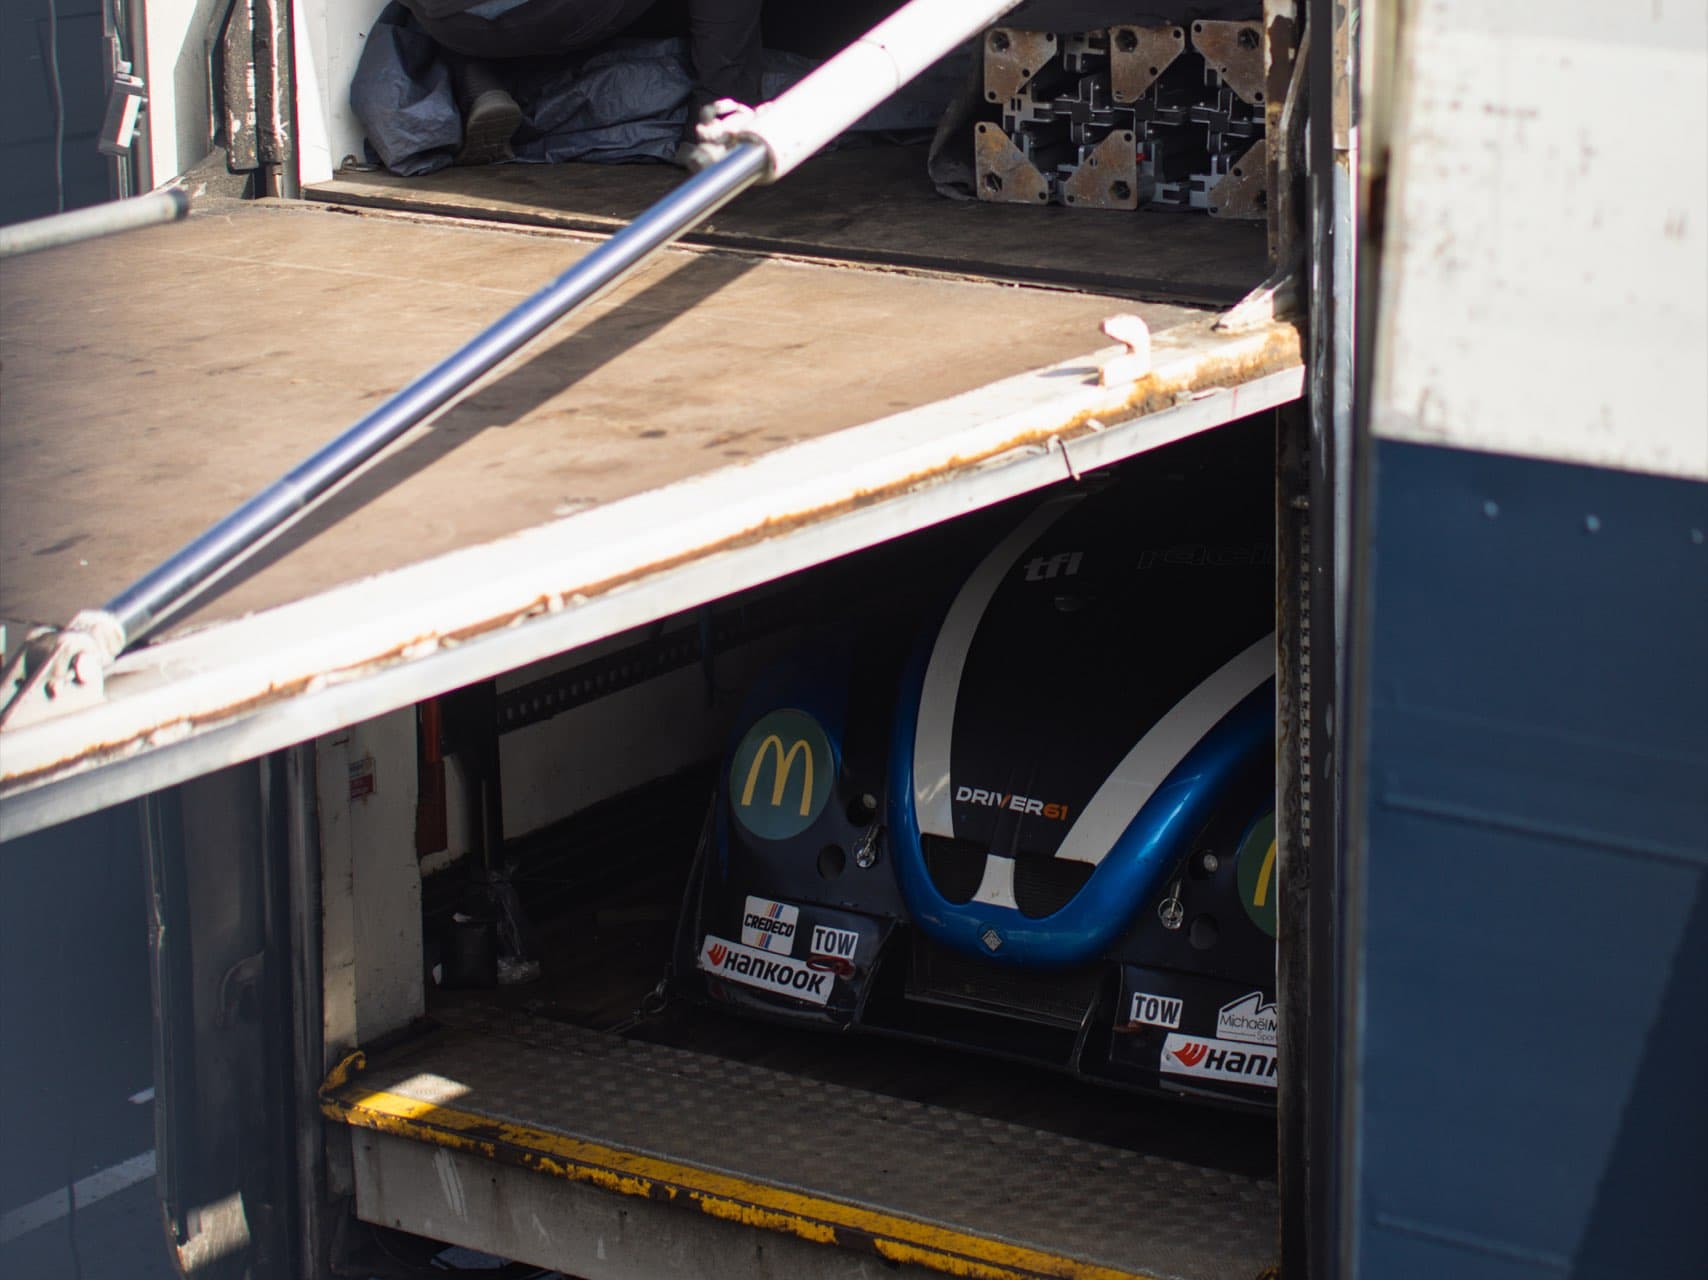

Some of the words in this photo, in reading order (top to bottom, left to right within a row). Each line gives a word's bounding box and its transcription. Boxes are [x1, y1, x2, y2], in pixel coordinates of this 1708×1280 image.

[956, 786, 1068, 821] DRIVER61
[744, 914, 794, 937] CREDECO
[814, 928, 856, 956] TOW
[1135, 995, 1181, 1024] TOW
